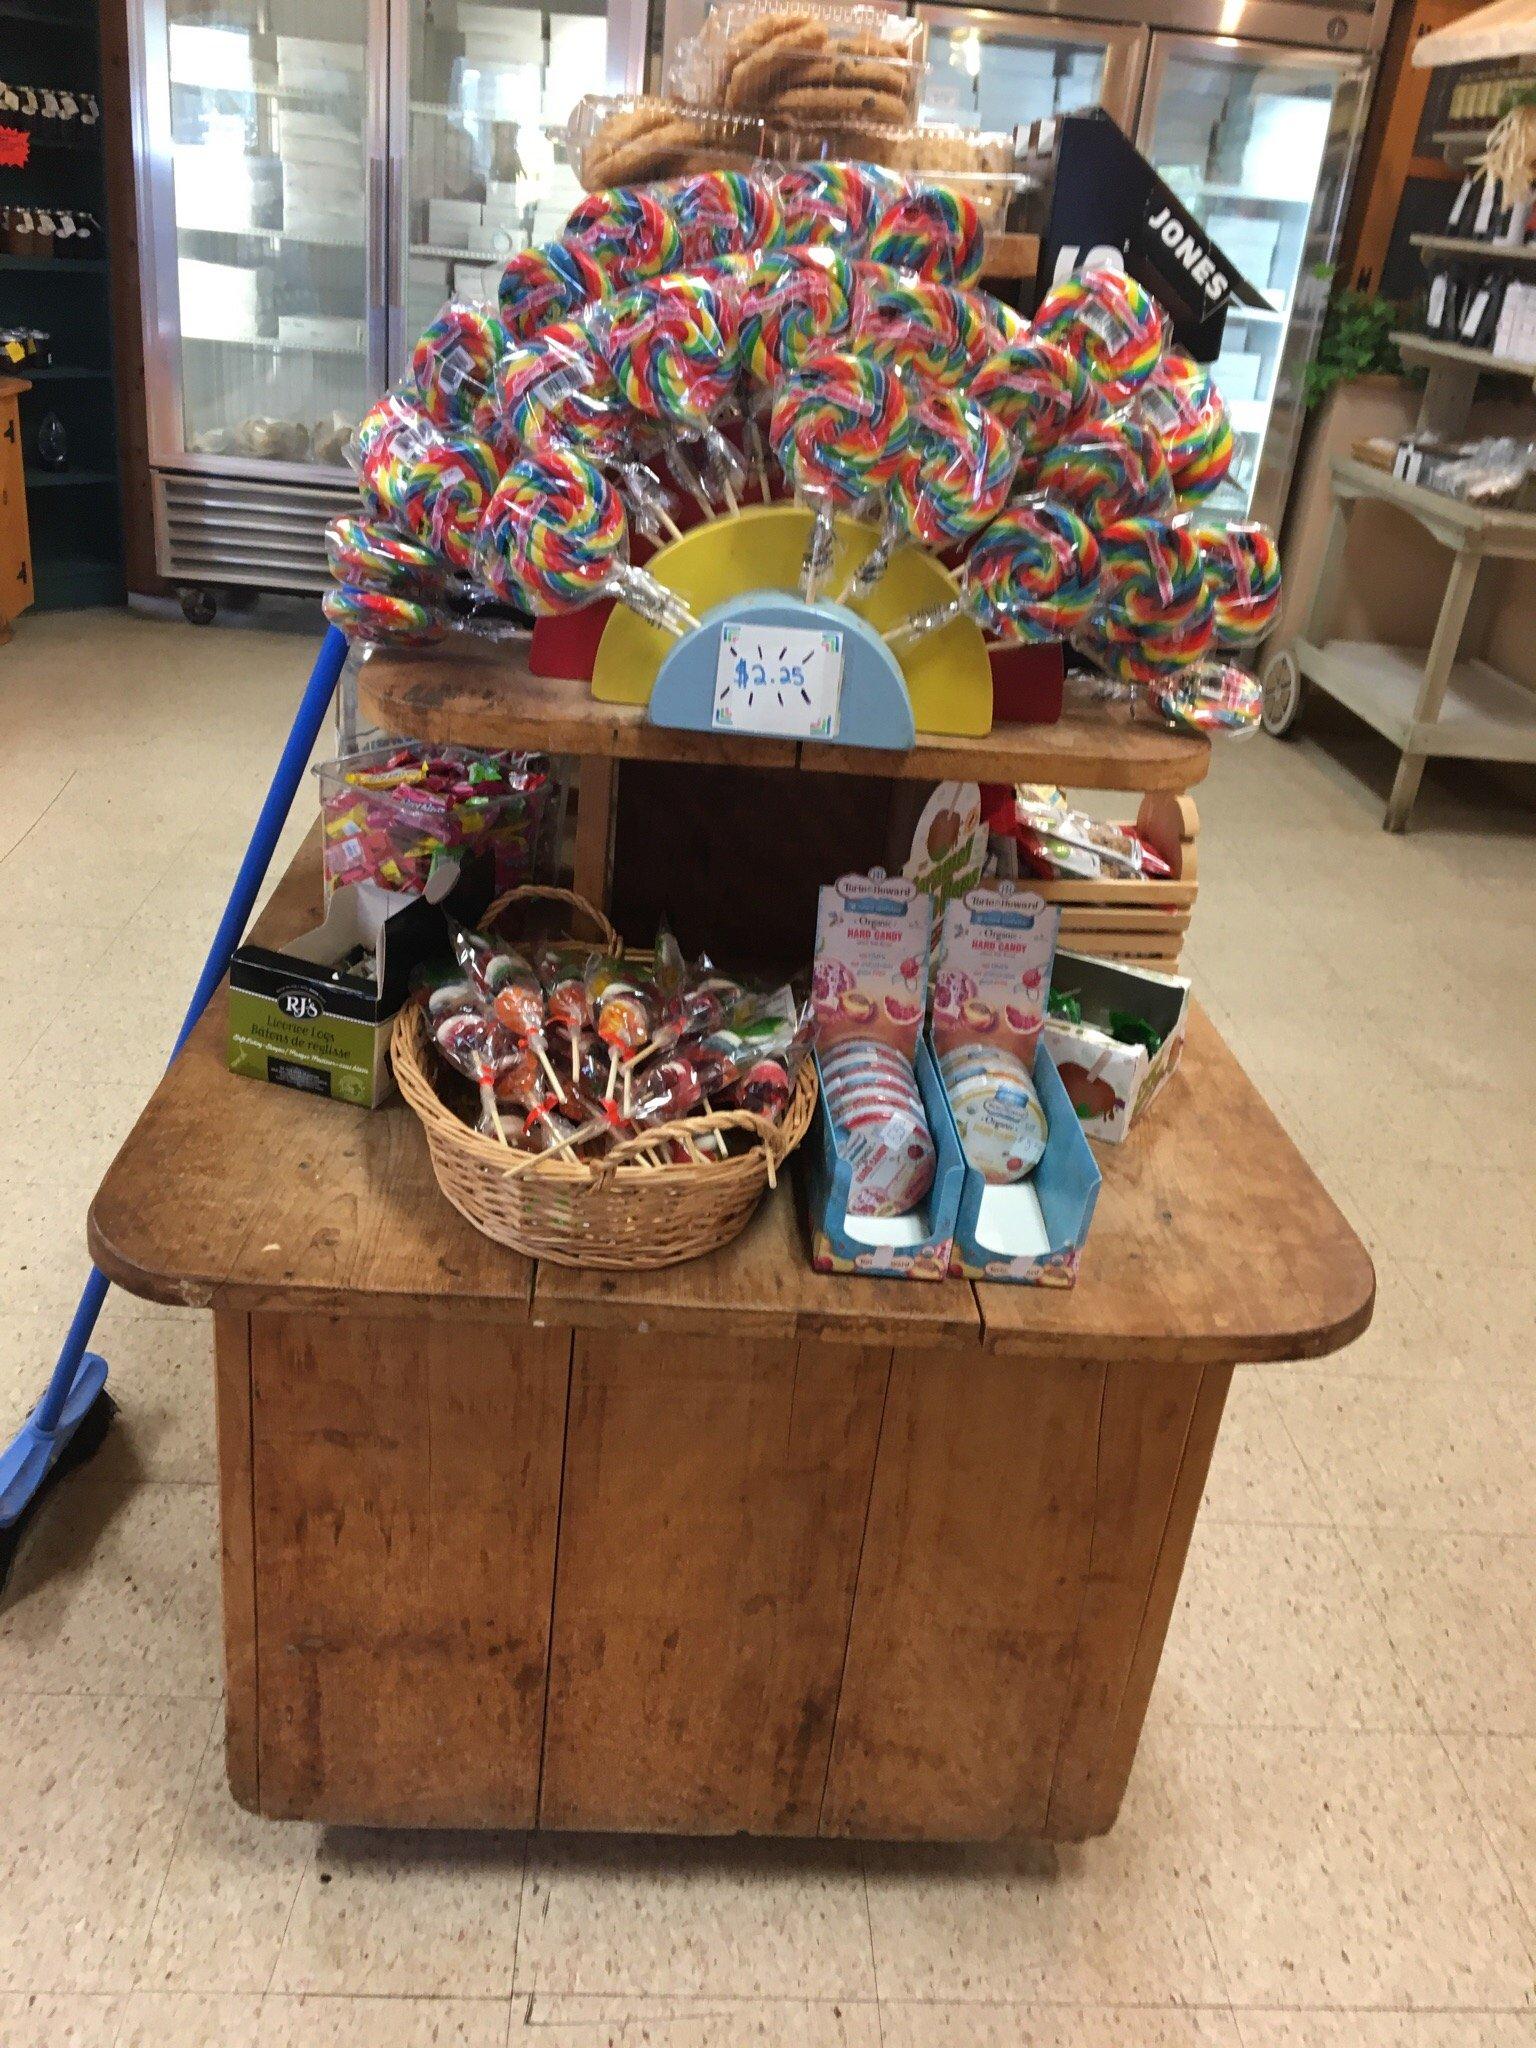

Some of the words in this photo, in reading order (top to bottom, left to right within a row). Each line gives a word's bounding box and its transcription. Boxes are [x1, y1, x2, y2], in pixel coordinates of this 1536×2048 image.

[1148, 207, 1229, 300] JONES
[734, 657, 805, 689] $2.25
[847, 928, 871, 940] HARD
[874, 930, 903, 942] CANDY
[971, 939, 996, 952] HARD
[998, 941, 1028, 954] CANDY
[291, 1035, 305, 1049] de
